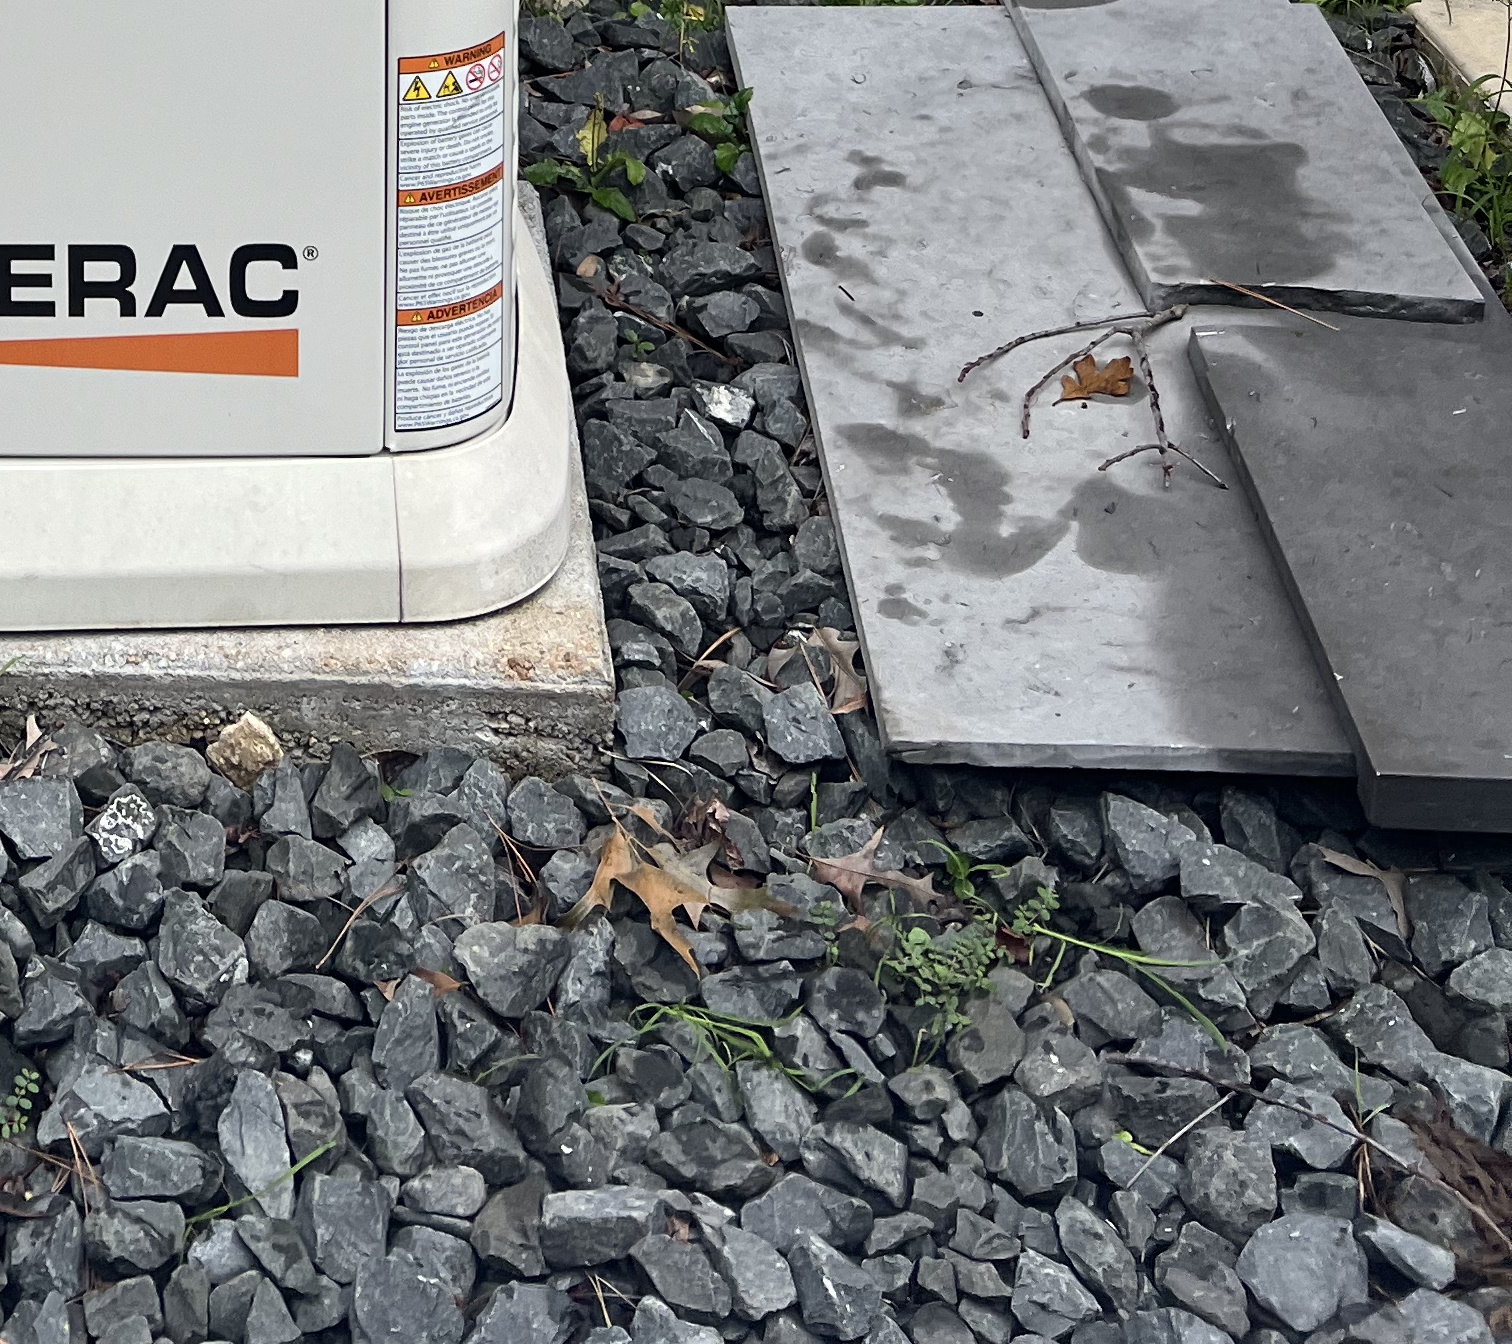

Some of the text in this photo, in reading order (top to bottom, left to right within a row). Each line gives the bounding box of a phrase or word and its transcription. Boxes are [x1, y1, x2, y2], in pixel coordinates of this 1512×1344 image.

[444, 44, 492, 66] WARNING
[419, 166, 503, 203] AVERTISSEMENT
[427, 288, 498, 321] ADVERTENCIA
